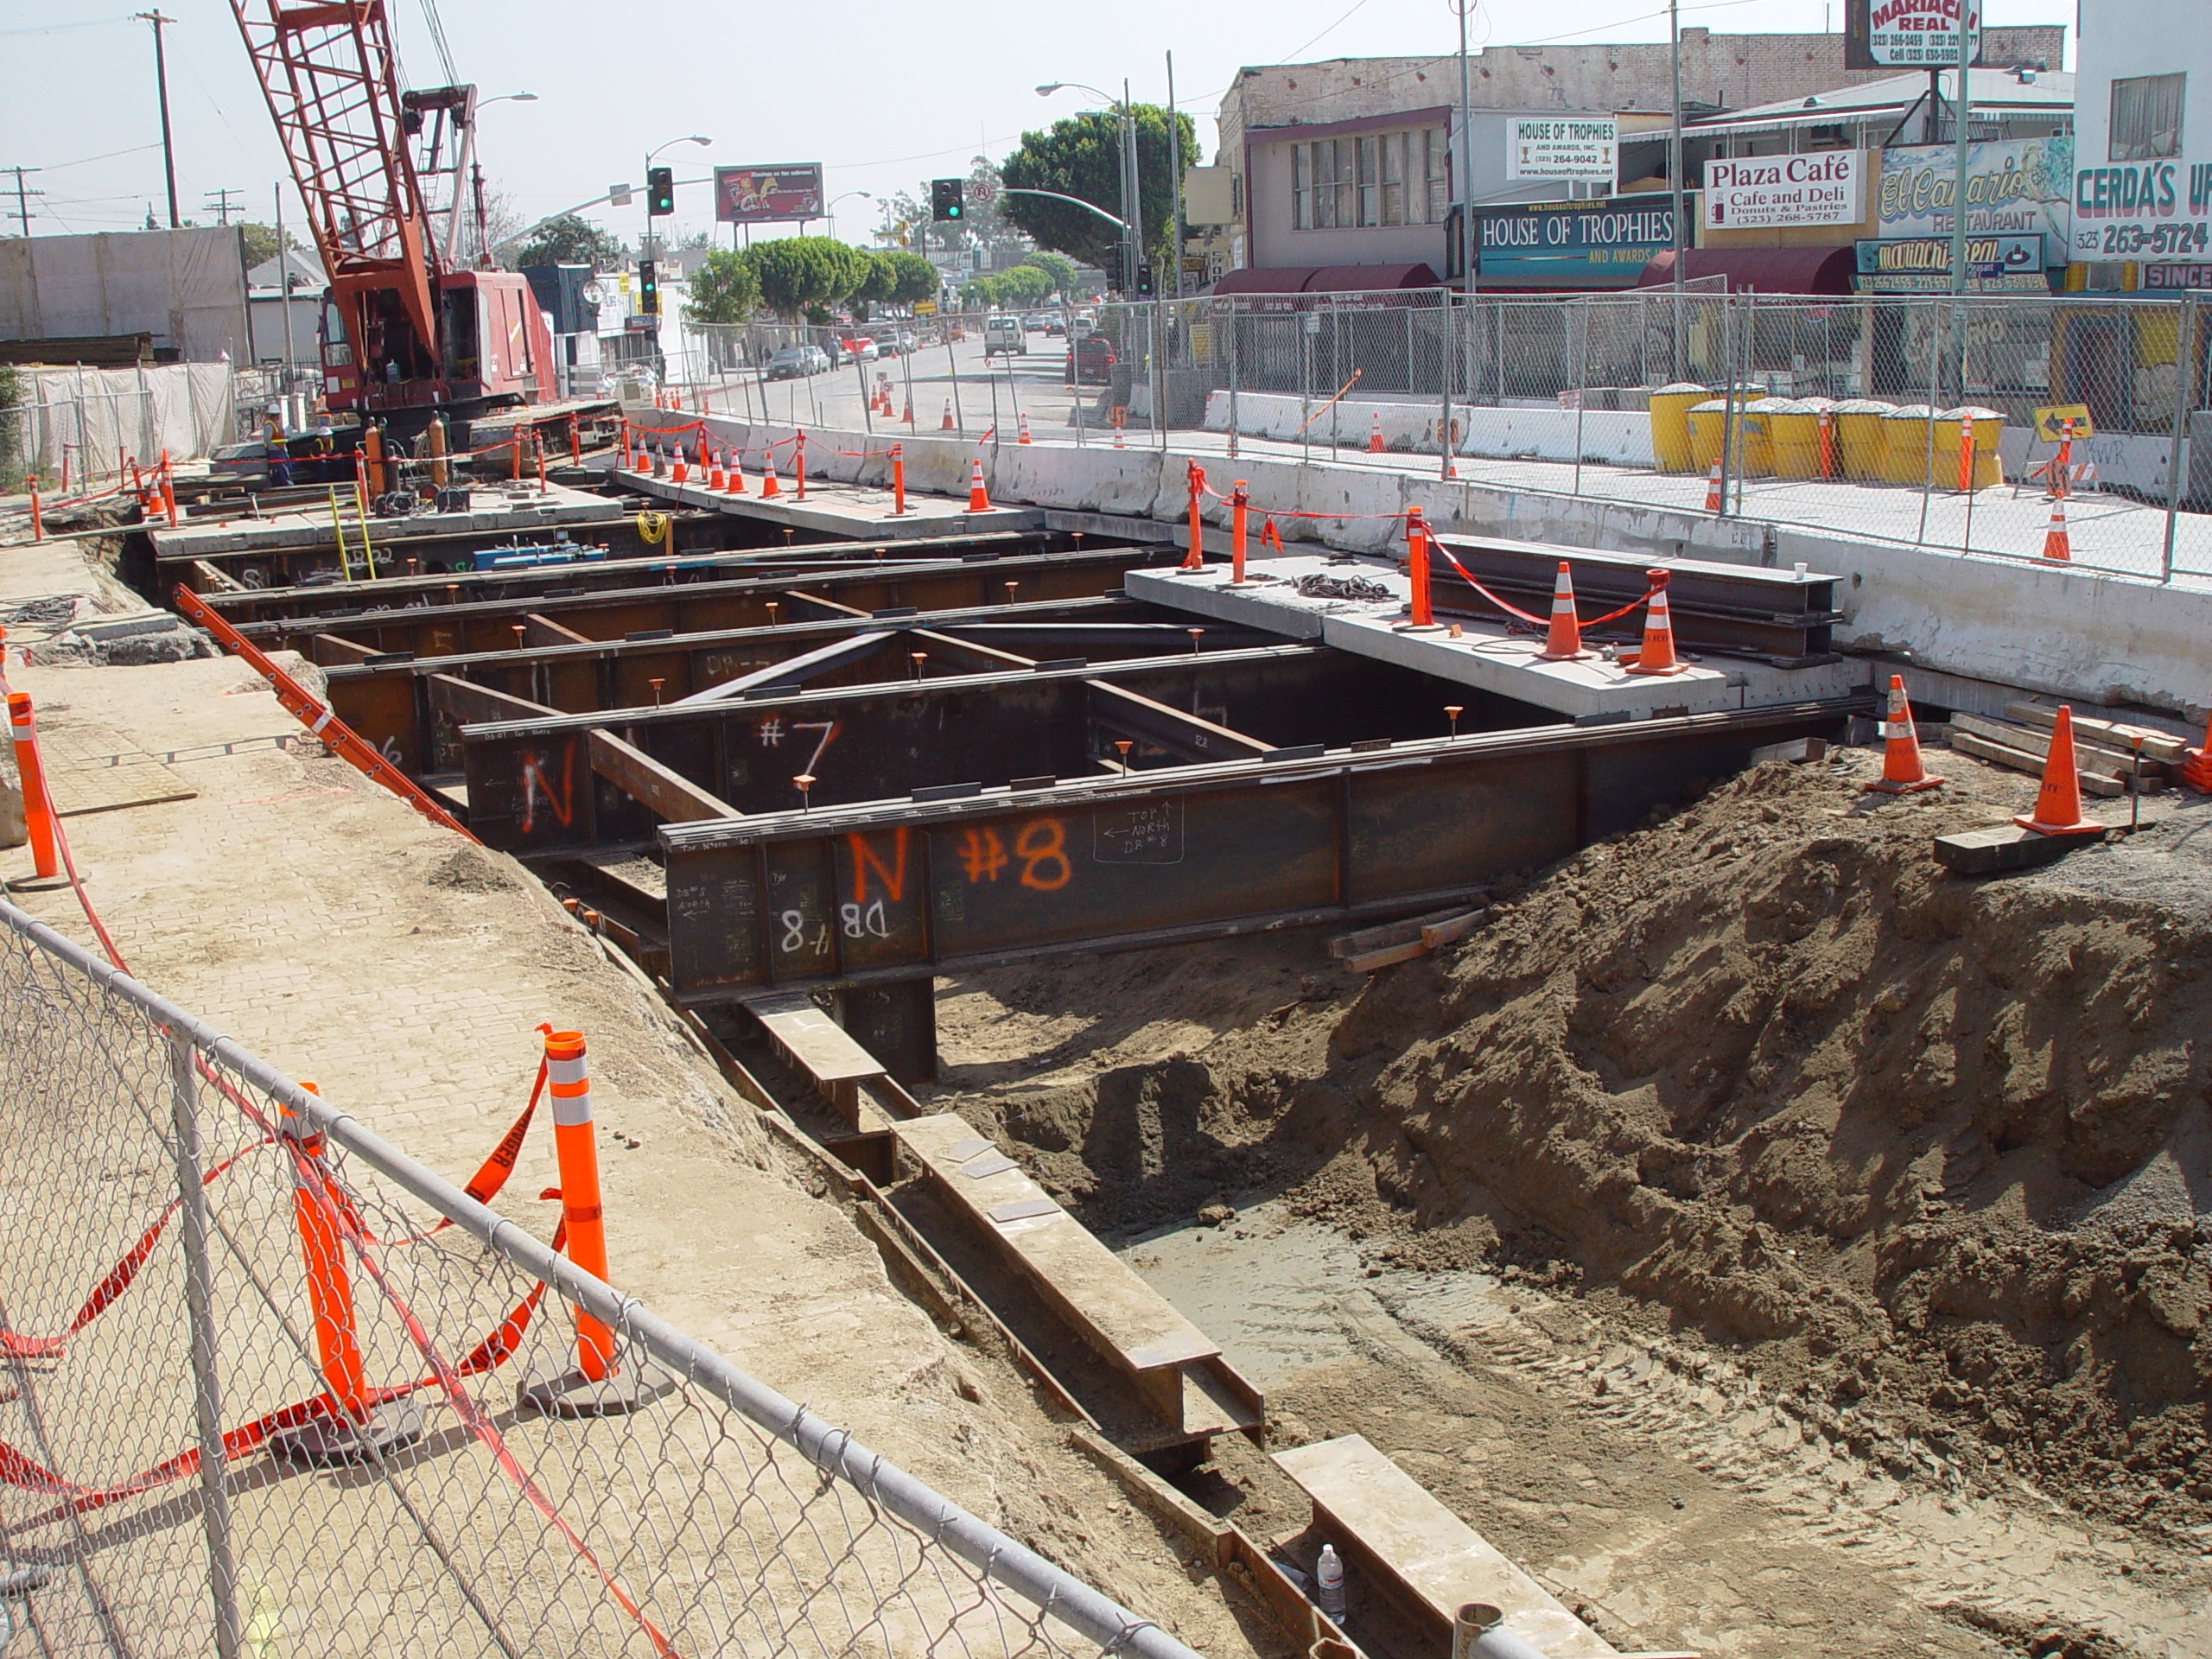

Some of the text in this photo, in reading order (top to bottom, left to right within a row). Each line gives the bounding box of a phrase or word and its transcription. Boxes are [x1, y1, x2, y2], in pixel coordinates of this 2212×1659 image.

[1898, 17, 1950, 31] REAL
[1518, 123, 1614, 140] HOUSE OF TROPHIES
[1553, 155, 1598, 163] 264-9042
[1711, 155, 1850, 188] Plaza Café
[1730, 187, 1845, 207] Cafe and Deli
[2076, 161, 2177, 219] CERDA'S
[1731, 207, 1777, 215] Donuts
[1796, 202, 1848, 213] Pastries
[1483, 211, 1674, 246] HOUSE OF TROPHIES
[1736, 212, 1840, 226] (323) 268-5787
[1932, 211, 2037, 232] RETAURANT
[2075, 222, 2209, 254] (323) 263-5724
[1589, 250, 1609, 264] AND
[2148, 264, 2212, 287] SINCE
[1128, 808, 1157, 823] TOP
[847, 825, 908, 903] N
[957, 817, 1072, 891] #8
